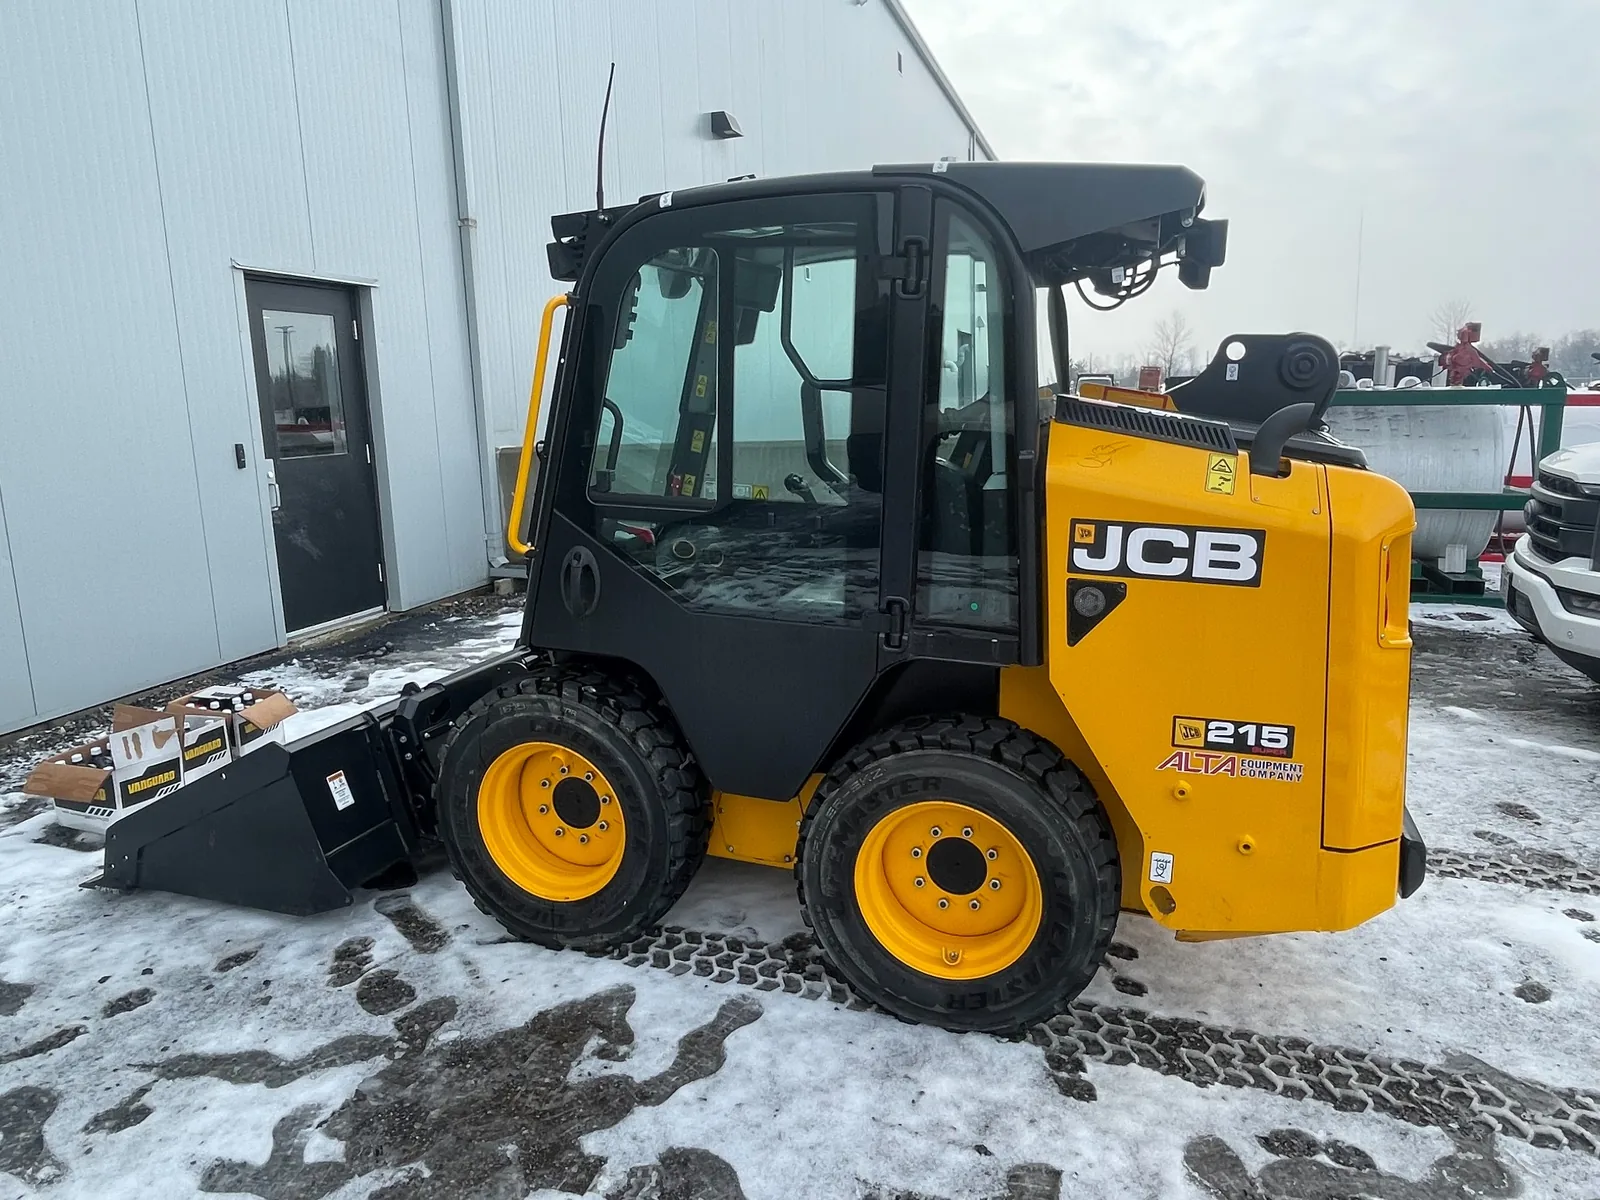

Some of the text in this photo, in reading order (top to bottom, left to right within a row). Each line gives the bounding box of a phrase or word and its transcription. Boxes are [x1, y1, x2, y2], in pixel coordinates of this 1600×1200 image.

[1073, 525, 1258, 582] JCB
[1182, 721, 1288, 749] JCB 215
[185, 738, 222, 761] VANGUARD
[1251, 748, 1288, 756] SUPER
[1157, 751, 1237, 777] ALTA
[1240, 770, 1303, 782] COMPANY
[1241, 759, 1304, 773] EQUIPMENT
[127, 770, 176, 795] VANGUARD
